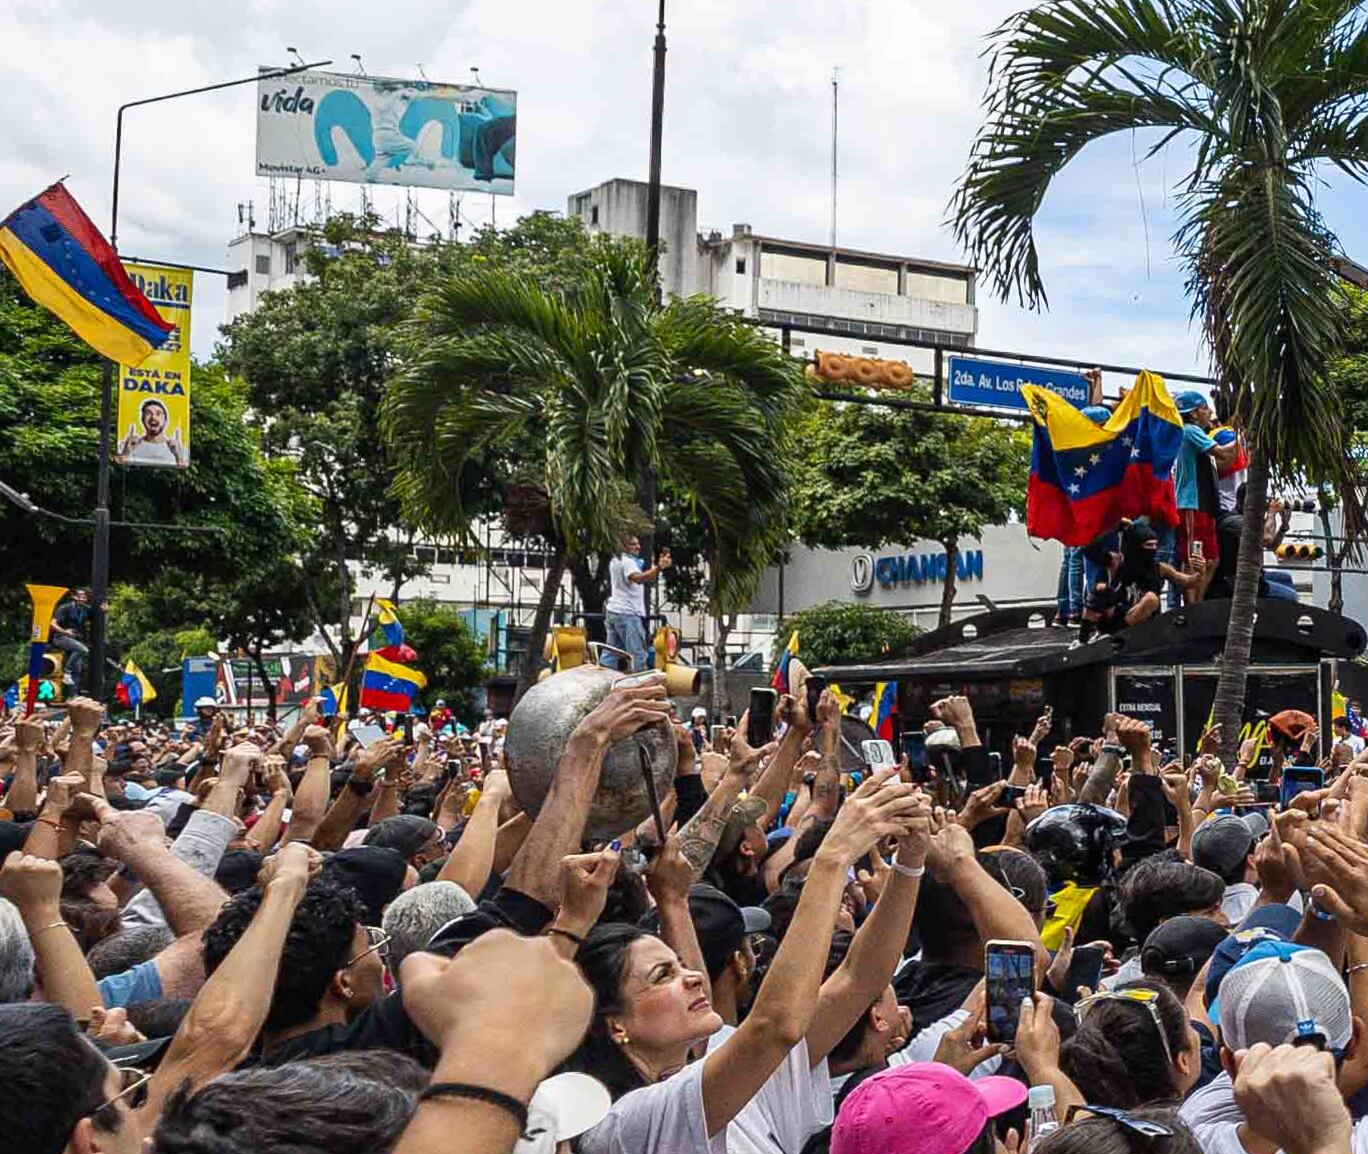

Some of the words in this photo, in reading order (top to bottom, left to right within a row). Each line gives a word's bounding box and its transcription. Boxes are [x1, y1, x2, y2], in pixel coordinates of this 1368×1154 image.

[261, 87, 314, 114] vida
[123, 378, 185, 396] DAKA
[954, 370, 975, 387] 2da.
[978, 374, 993, 389] Av.
[996, 376, 1014, 391] Los
